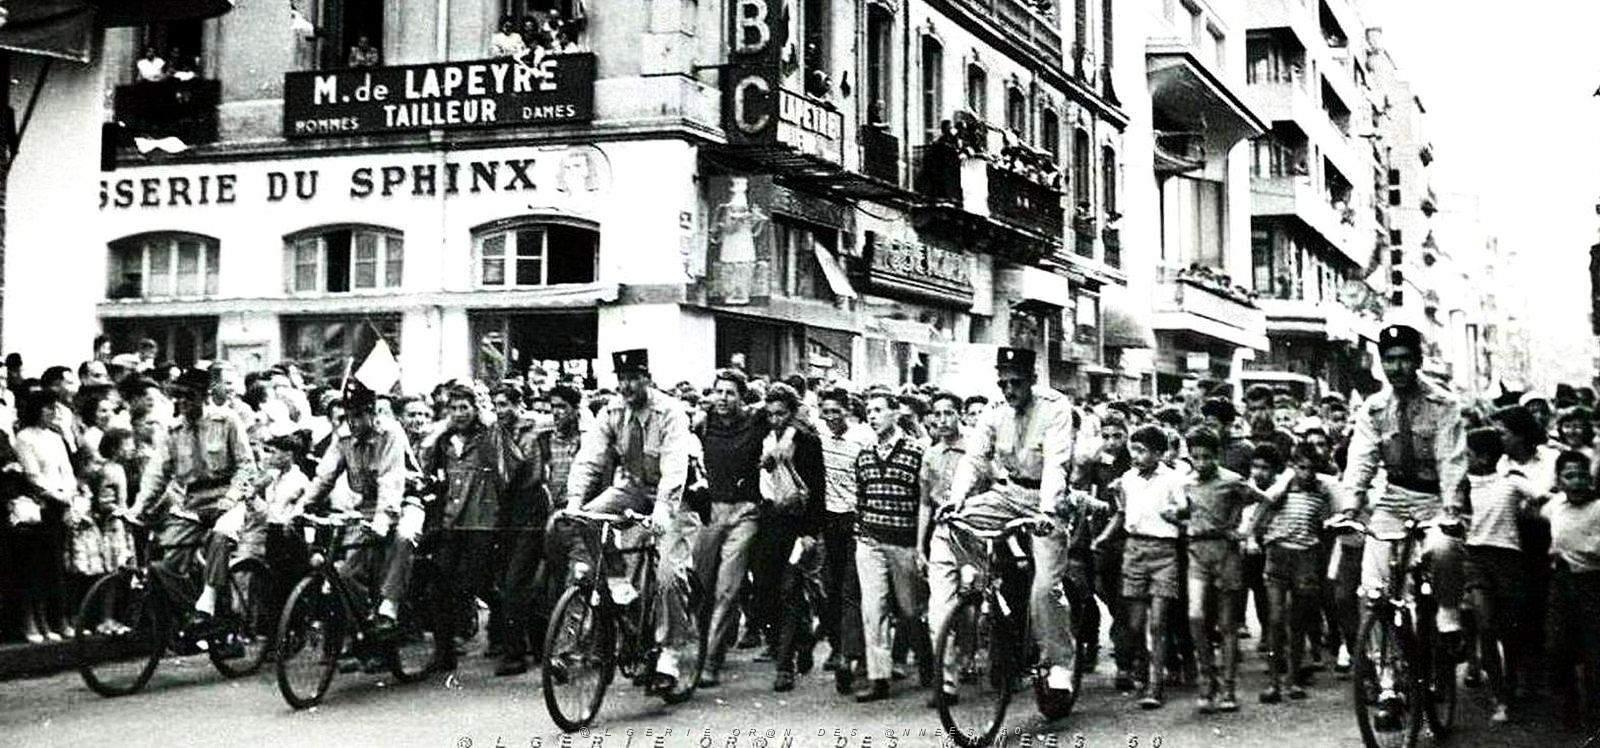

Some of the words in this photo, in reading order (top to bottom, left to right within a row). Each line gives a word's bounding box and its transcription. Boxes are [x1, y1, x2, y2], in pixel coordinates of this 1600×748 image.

[405, 60, 557, 99] LAPEYRE
[384, 98, 497, 127] TAILLEUR
[522, 104, 576, 119] DAMES
[267, 170, 319, 202] DU
[350, 159, 537, 199] SPHINX
